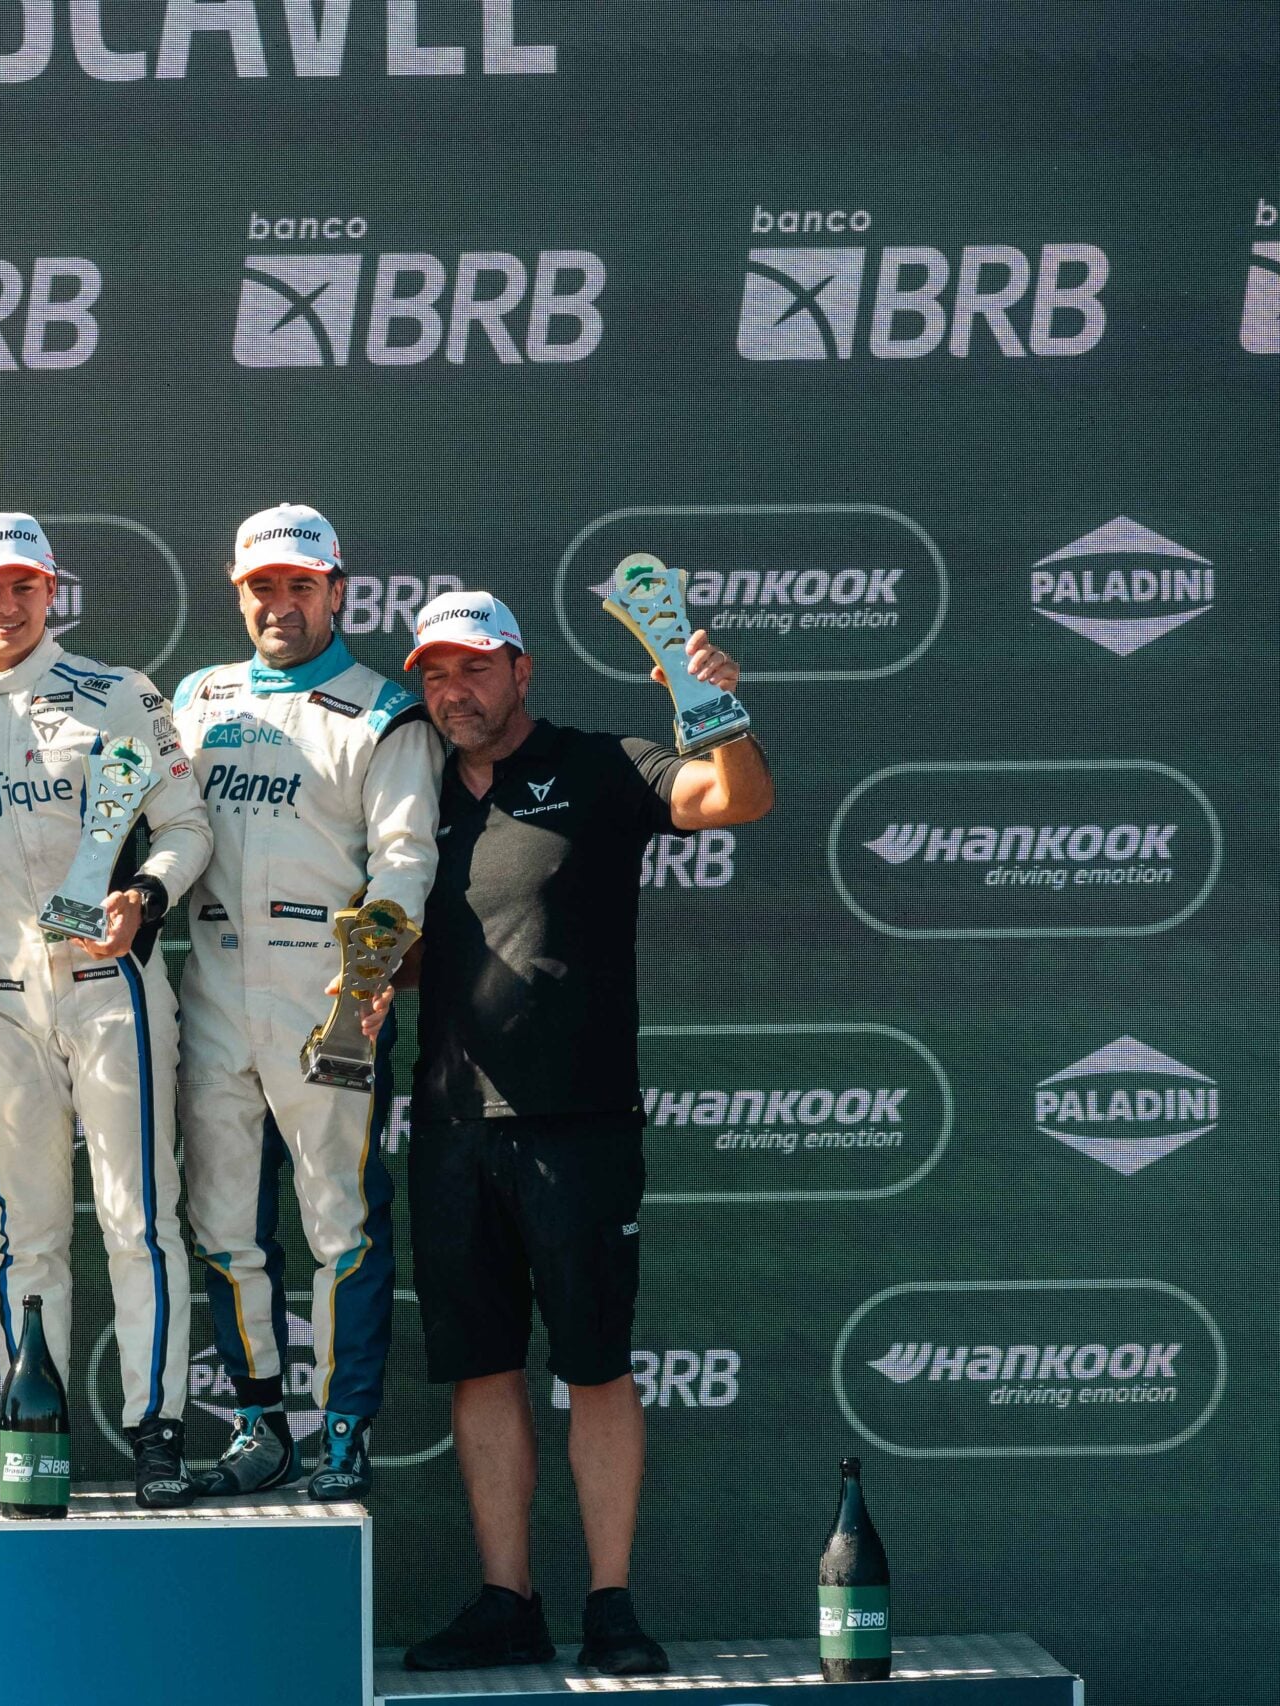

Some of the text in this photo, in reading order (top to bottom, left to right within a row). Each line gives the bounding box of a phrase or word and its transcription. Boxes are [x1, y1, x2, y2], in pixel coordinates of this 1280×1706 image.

[248, 212, 368, 240] banco
[752, 205, 872, 232] banco
[365, 250, 607, 366] BRB
[869, 243, 1110, 359] BRB
[1031, 569, 1215, 602] PALADINI
[711, 608, 899, 634] driving emotion
[206, 727, 284, 746] CARONE
[203, 764, 302, 807] Planet
[216, 804, 301, 820] RAVEL
[513, 801, 570, 817] CUPRA
[640, 828, 736, 887] RB
[984, 865, 1173, 891] driving emotion
[267, 939, 319, 949] MAGLIONE
[1035, 1088, 1219, 1122] PALADINI
[715, 1127, 904, 1154] driving emotion
[989, 1382, 1177, 1408] driving emotion
[52, 1460, 70, 1474] BRB
[820, 1607, 844, 1620] CR
[861, 1612, 885, 1627] BRB
